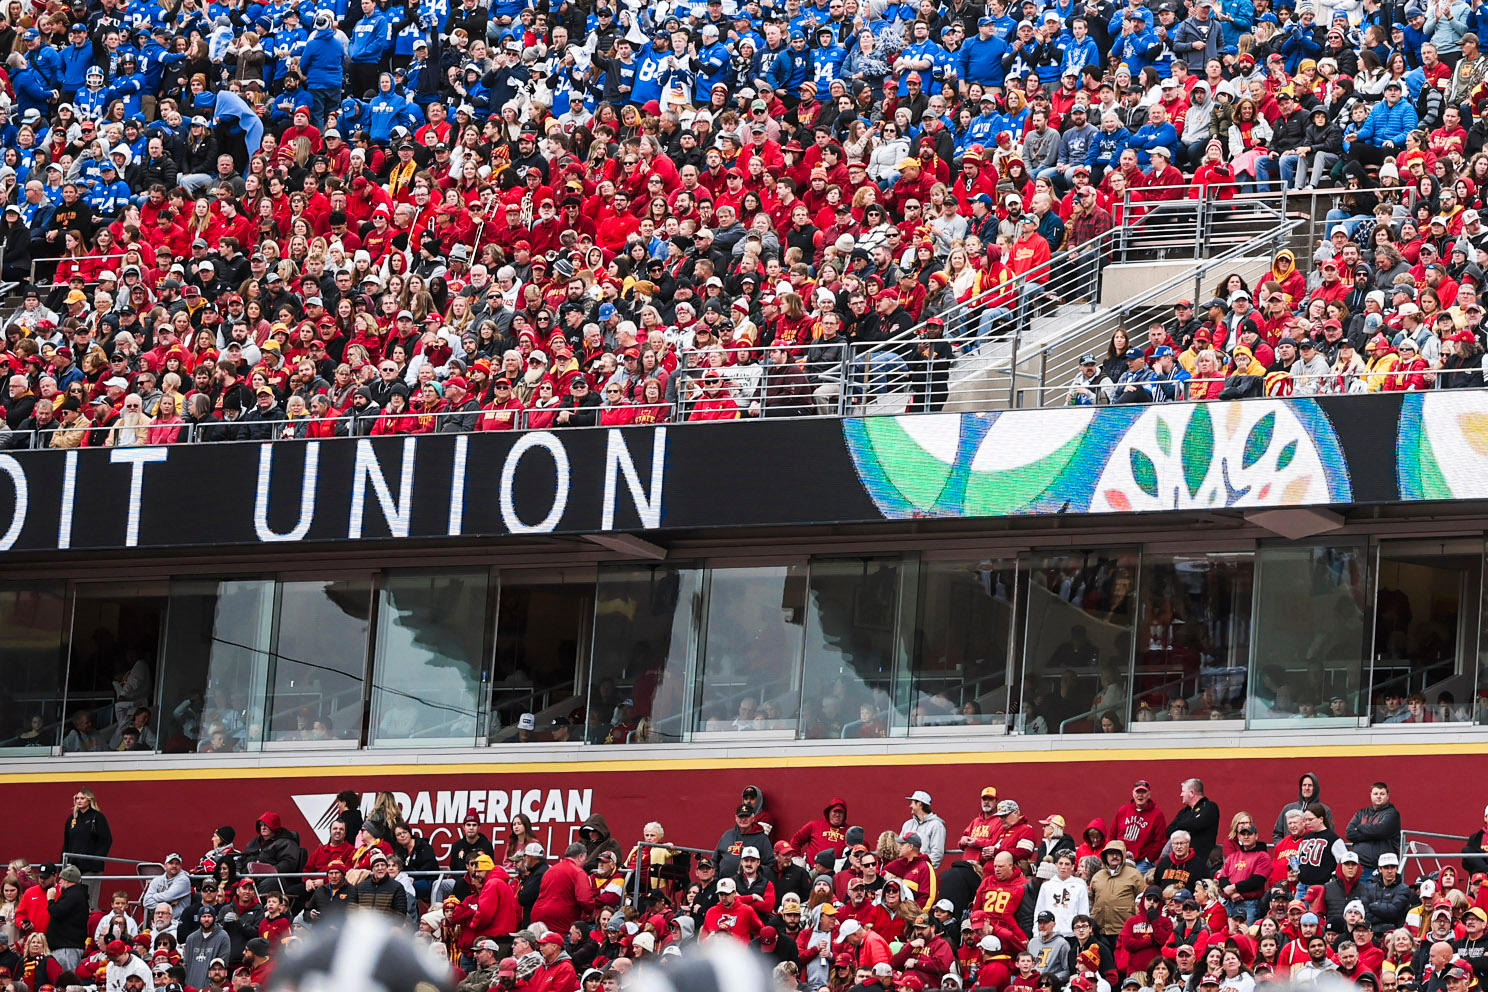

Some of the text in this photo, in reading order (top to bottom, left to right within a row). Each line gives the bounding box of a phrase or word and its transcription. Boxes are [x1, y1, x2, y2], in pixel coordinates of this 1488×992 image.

[254, 426, 667, 543] UNION
[1124, 816, 1148, 829] AMES
[822, 832, 844, 840] STATE
[983, 892, 1011, 913] 28
